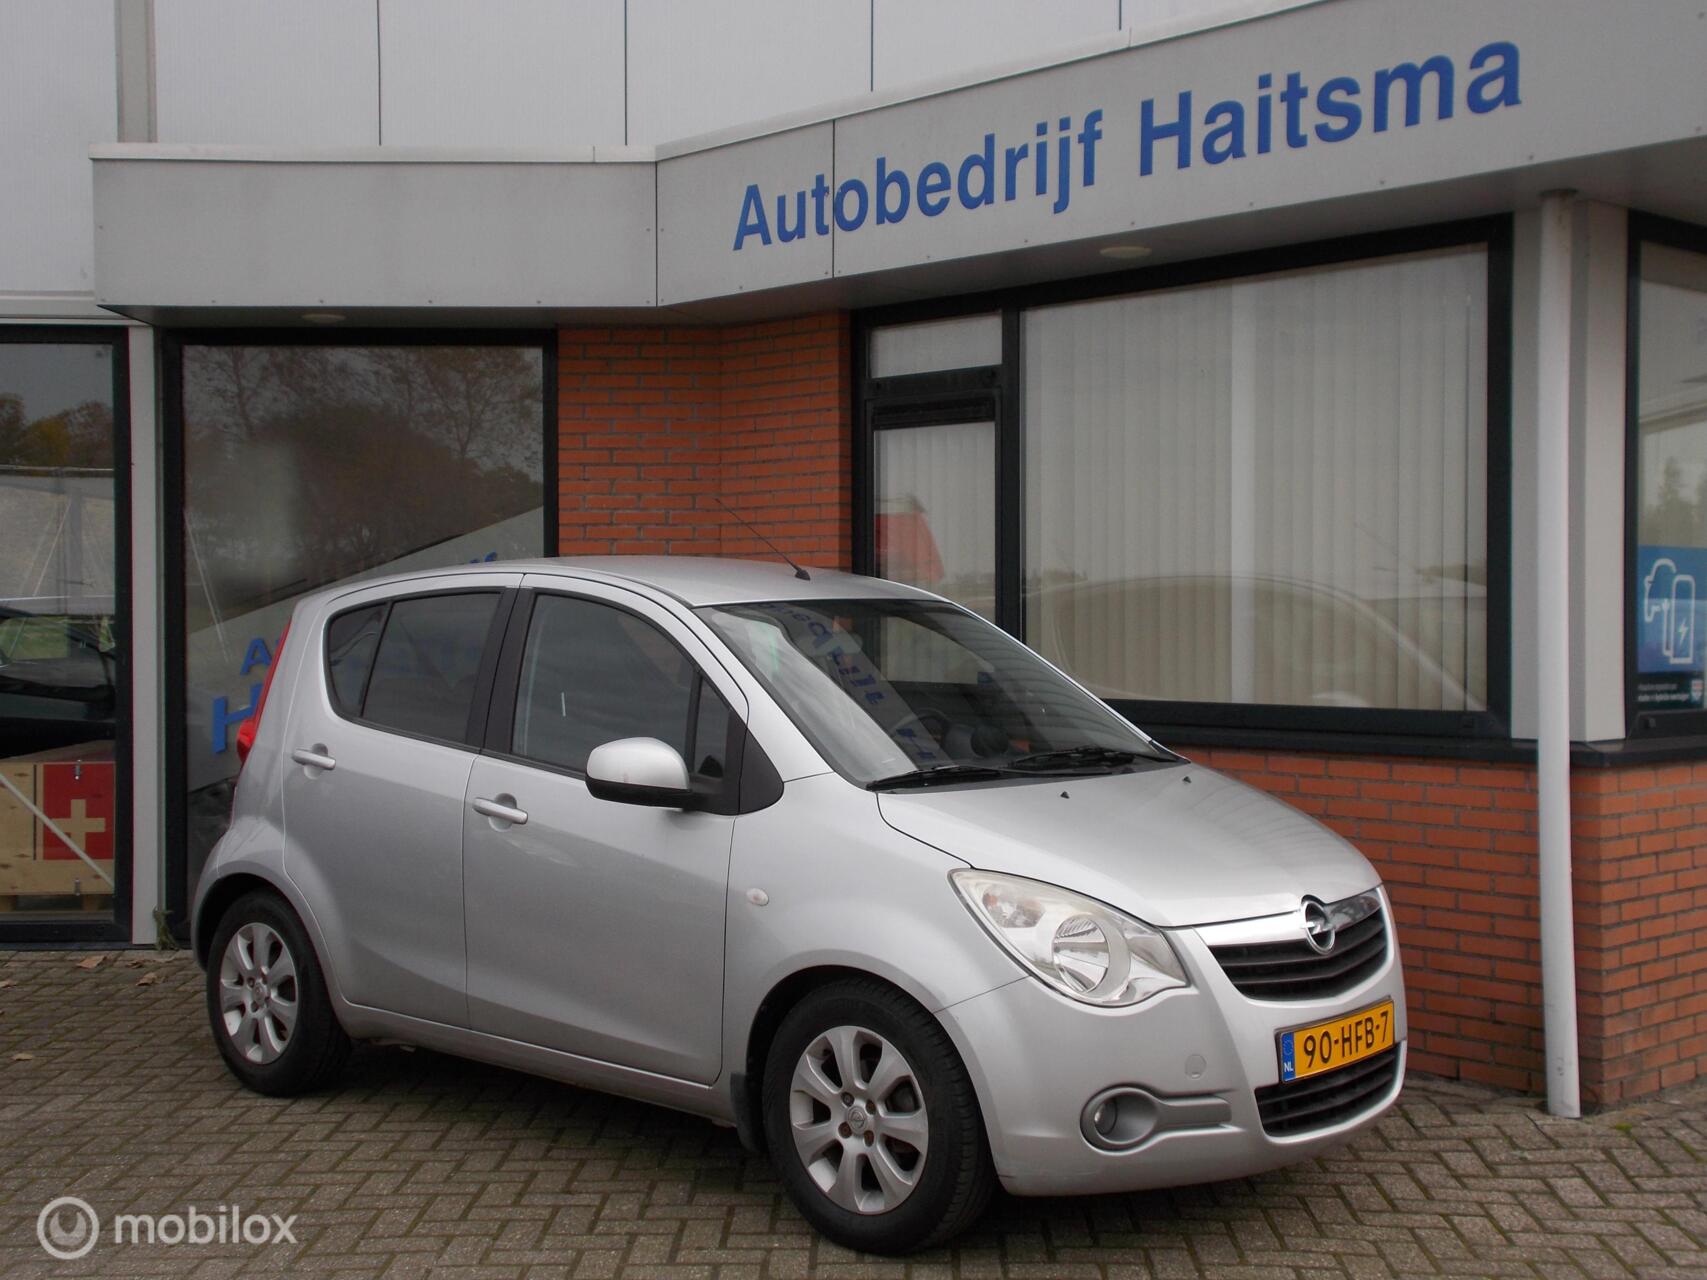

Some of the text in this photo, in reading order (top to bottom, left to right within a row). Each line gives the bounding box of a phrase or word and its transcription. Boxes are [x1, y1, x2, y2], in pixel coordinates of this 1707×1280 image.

[735, 42, 1521, 250] Autobedrijf Haitsma
[1284, 1062, 1294, 1073] NL
[1303, 1010, 1389, 1068] 90-HFB-7
